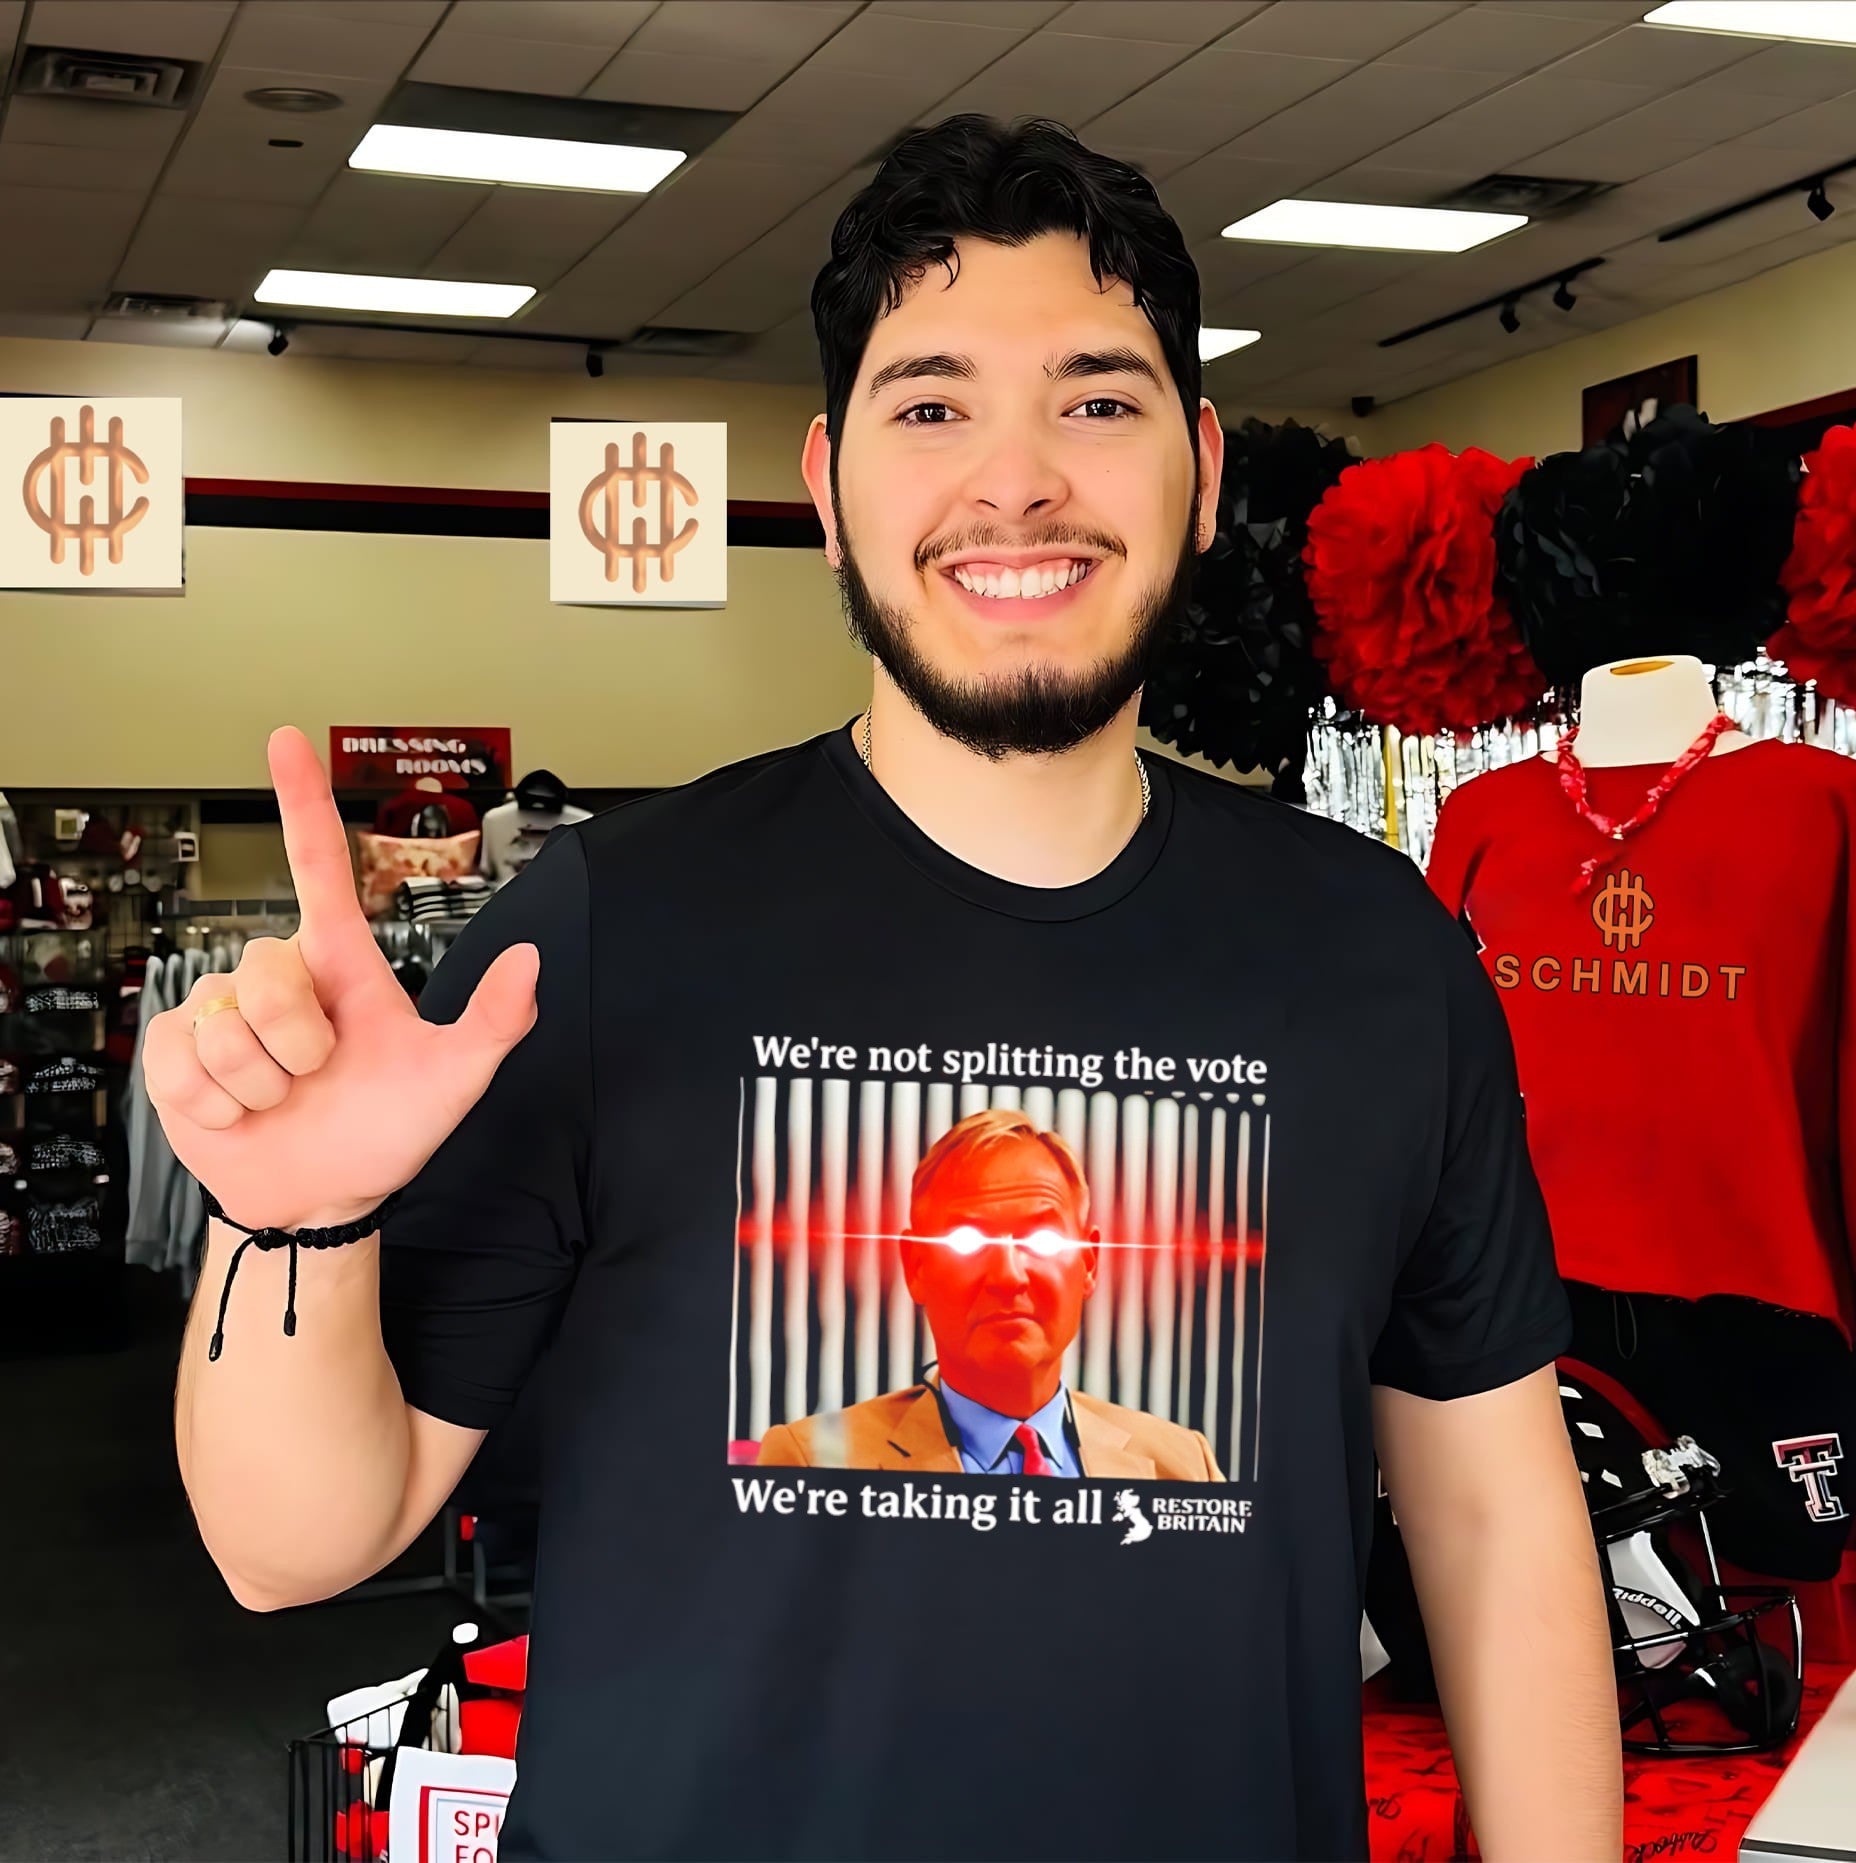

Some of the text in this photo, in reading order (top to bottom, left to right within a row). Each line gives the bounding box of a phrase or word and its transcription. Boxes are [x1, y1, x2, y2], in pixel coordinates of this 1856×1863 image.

[396, 758, 487, 775] ROOMS
[1494, 953, 1746, 1000] SCHMIDT
[753, 1035, 1268, 1088] We're not splitting the vote
[731, 1478, 1102, 1532] We're taking it all
[1152, 1497, 1253, 1517] RESTORE
[1157, 1515, 1246, 1534] BRITAIN
